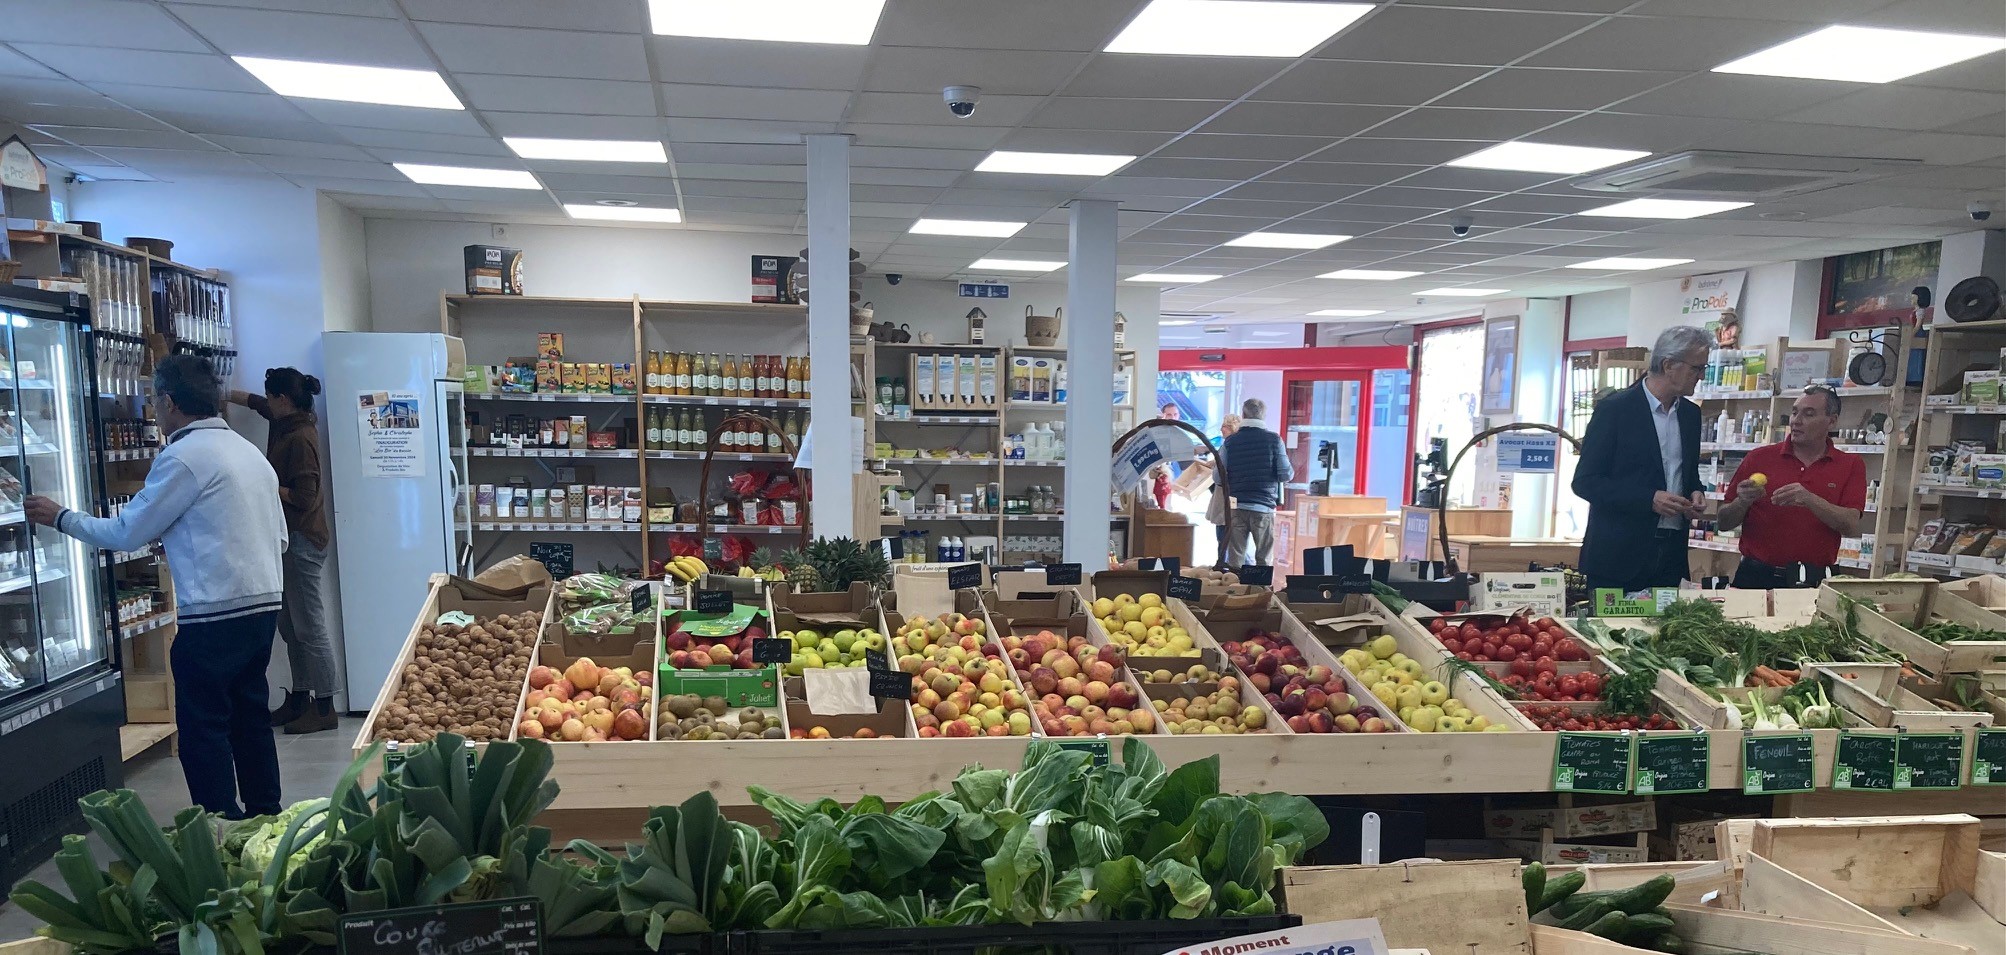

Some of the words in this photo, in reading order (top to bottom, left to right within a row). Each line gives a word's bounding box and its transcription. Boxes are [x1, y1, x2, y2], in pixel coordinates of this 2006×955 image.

[951, 572, 980, 585] ELSTAR
[750, 694, 771, 703] Juliet
[1754, 744, 1793, 760] FENOUIL
[1617, 782, 1623, 790] €
[1698, 780, 1704, 788] €
[1804, 780, 1811, 788] €
[1950, 778, 1957, 786] €
[345, 920, 374, 928] Produit
[1200, 935, 1290, 955] Moment
